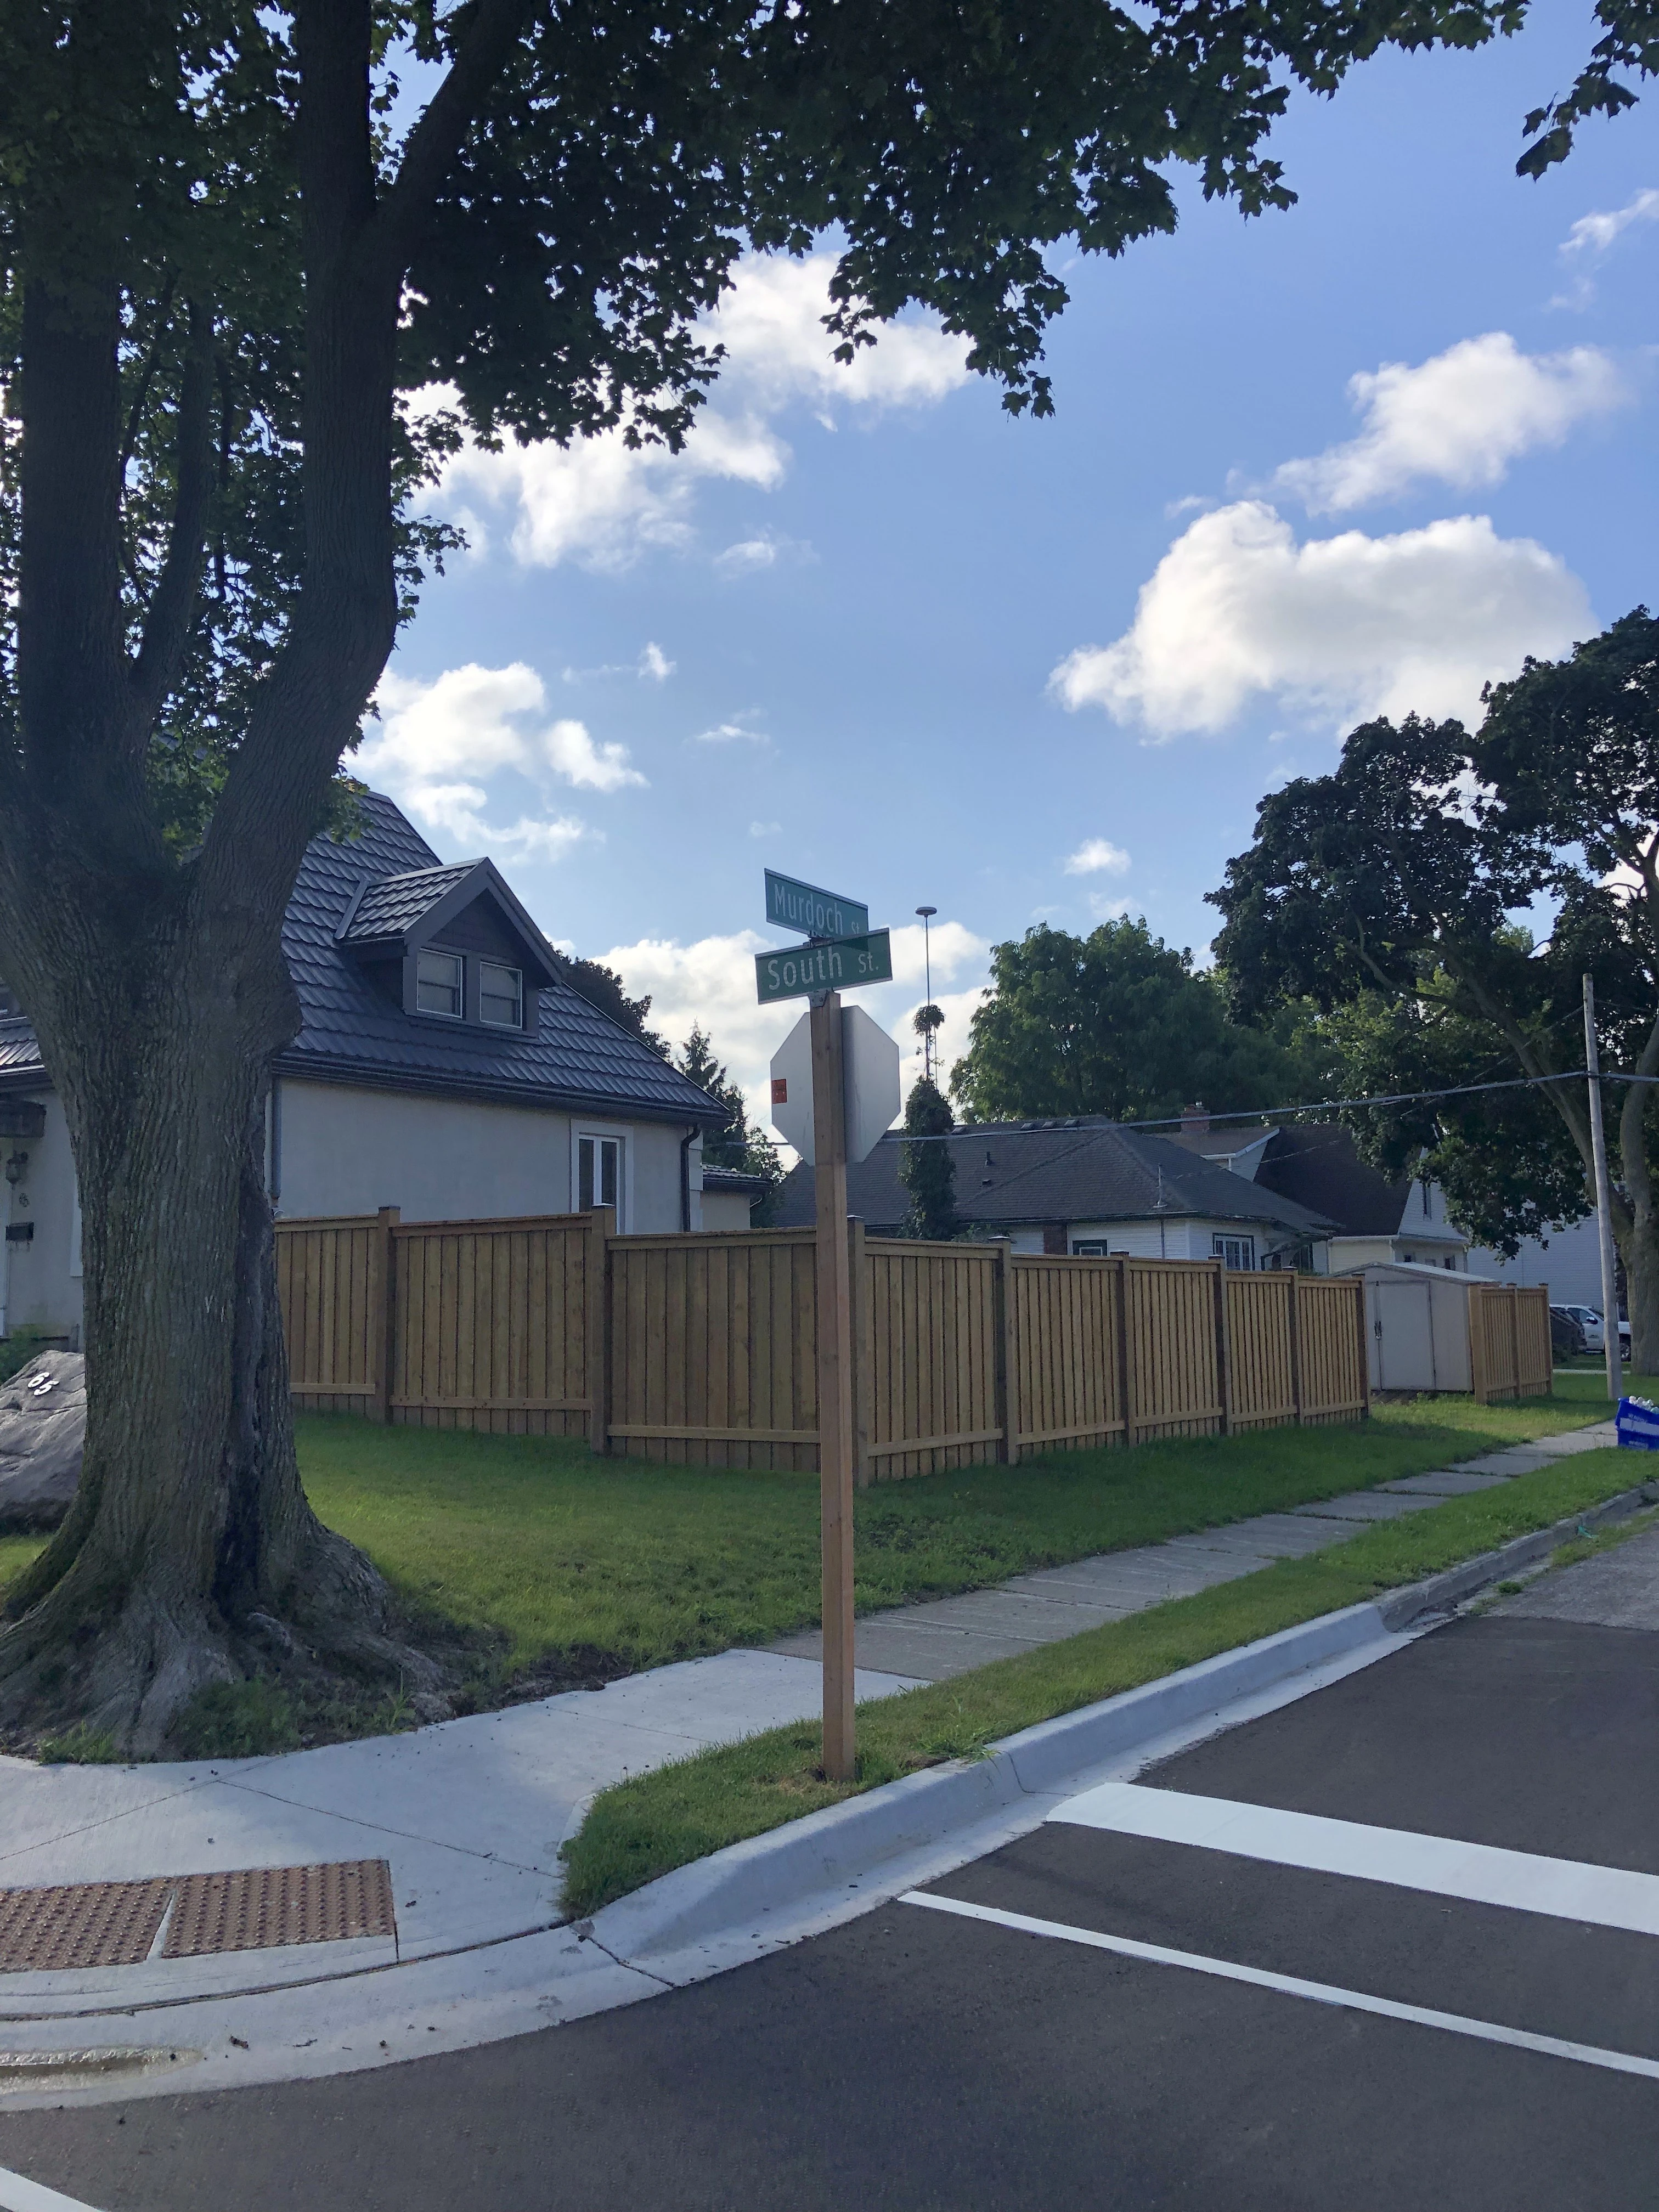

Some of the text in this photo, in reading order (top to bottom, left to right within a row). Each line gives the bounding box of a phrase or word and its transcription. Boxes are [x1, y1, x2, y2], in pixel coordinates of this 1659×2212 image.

[774, 884, 843, 935] Murdoch
[768, 945, 879, 990] South St.
[27, 1372, 59, 1396] 65
